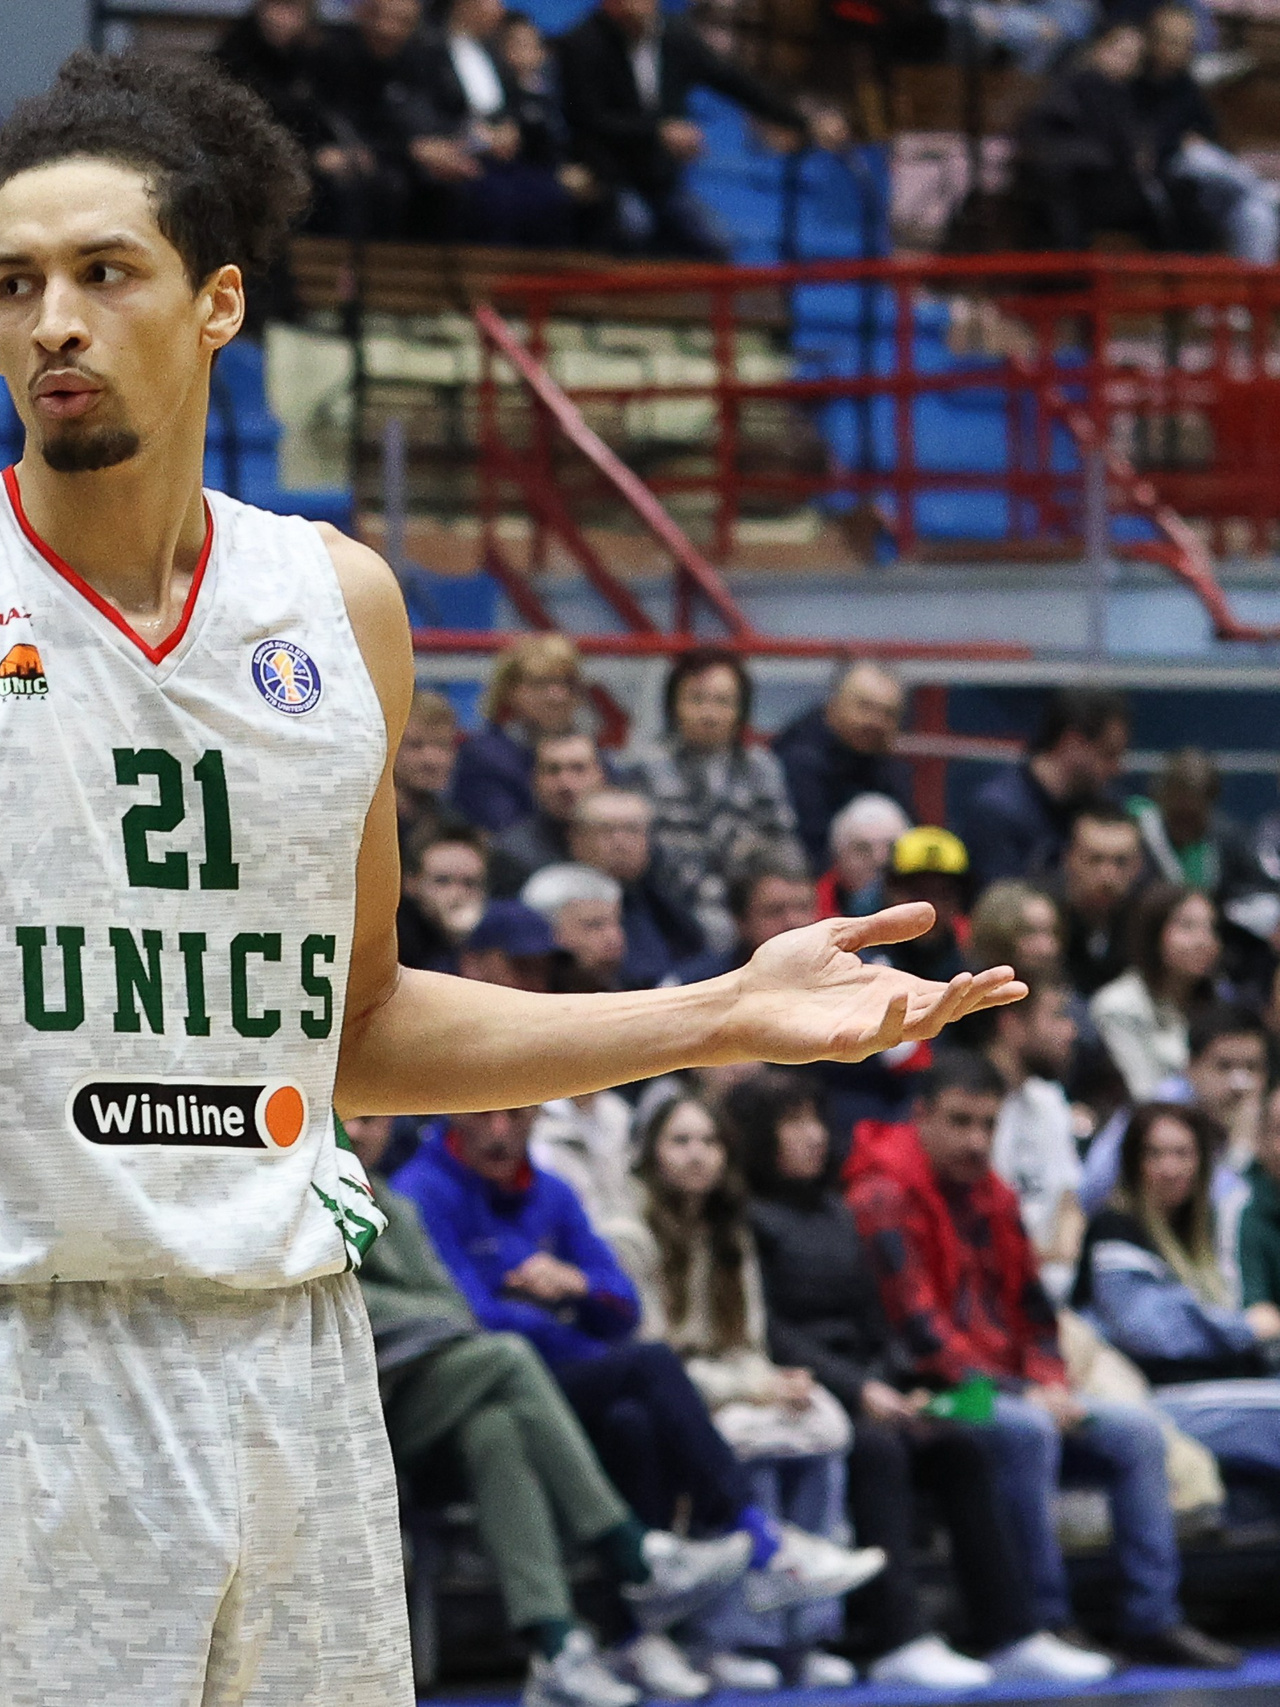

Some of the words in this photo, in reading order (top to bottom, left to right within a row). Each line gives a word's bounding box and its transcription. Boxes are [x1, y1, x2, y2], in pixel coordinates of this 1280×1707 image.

[112, 748, 239, 890] 21
[16, 926, 336, 1039] UNICS
[90, 1093, 245, 1137] Winline
